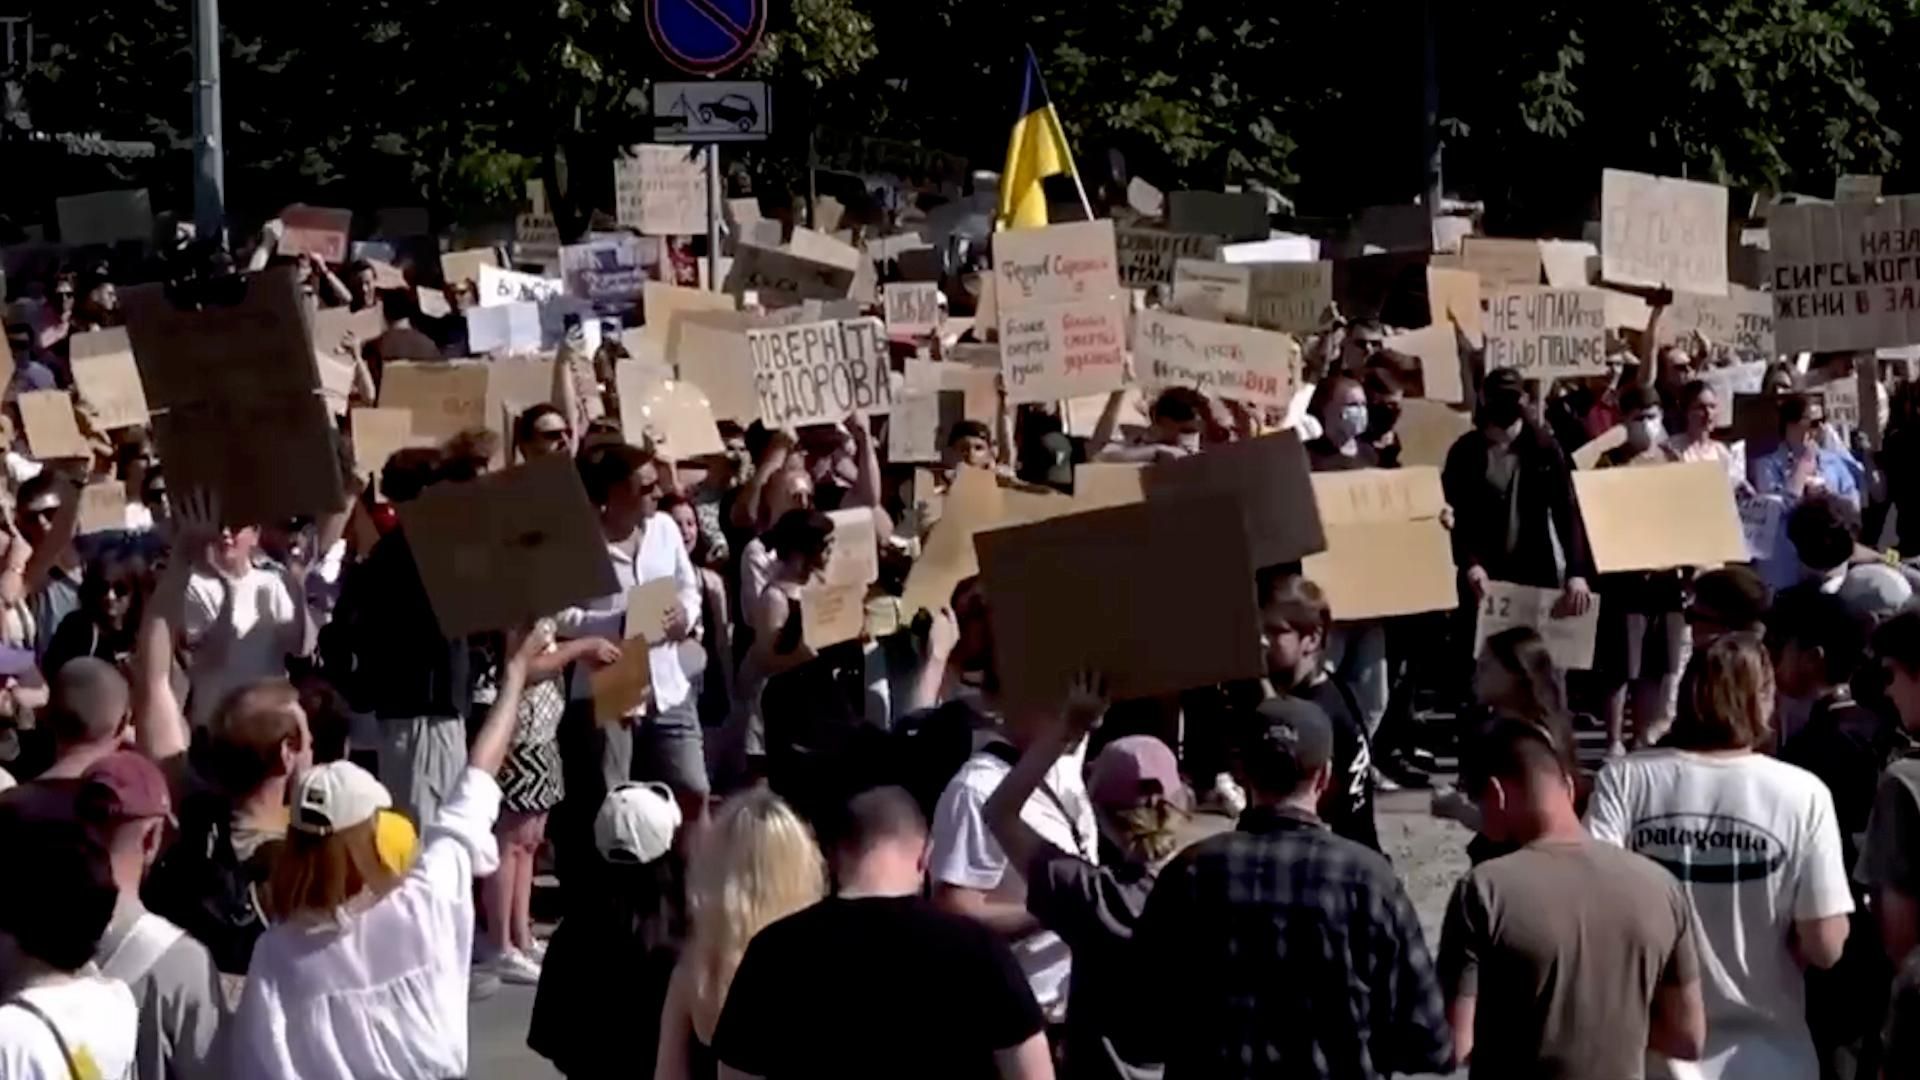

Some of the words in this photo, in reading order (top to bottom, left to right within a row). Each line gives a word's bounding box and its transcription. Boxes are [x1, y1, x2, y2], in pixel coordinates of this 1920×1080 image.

[1494, 296, 1520, 332] НЕ
[1777, 291, 1844, 319] ЖЕНИ
[1856, 290, 1870, 314] В
[1885, 286, 1920, 312] ЗА
[1638, 823, 1768, 851] patagonia
